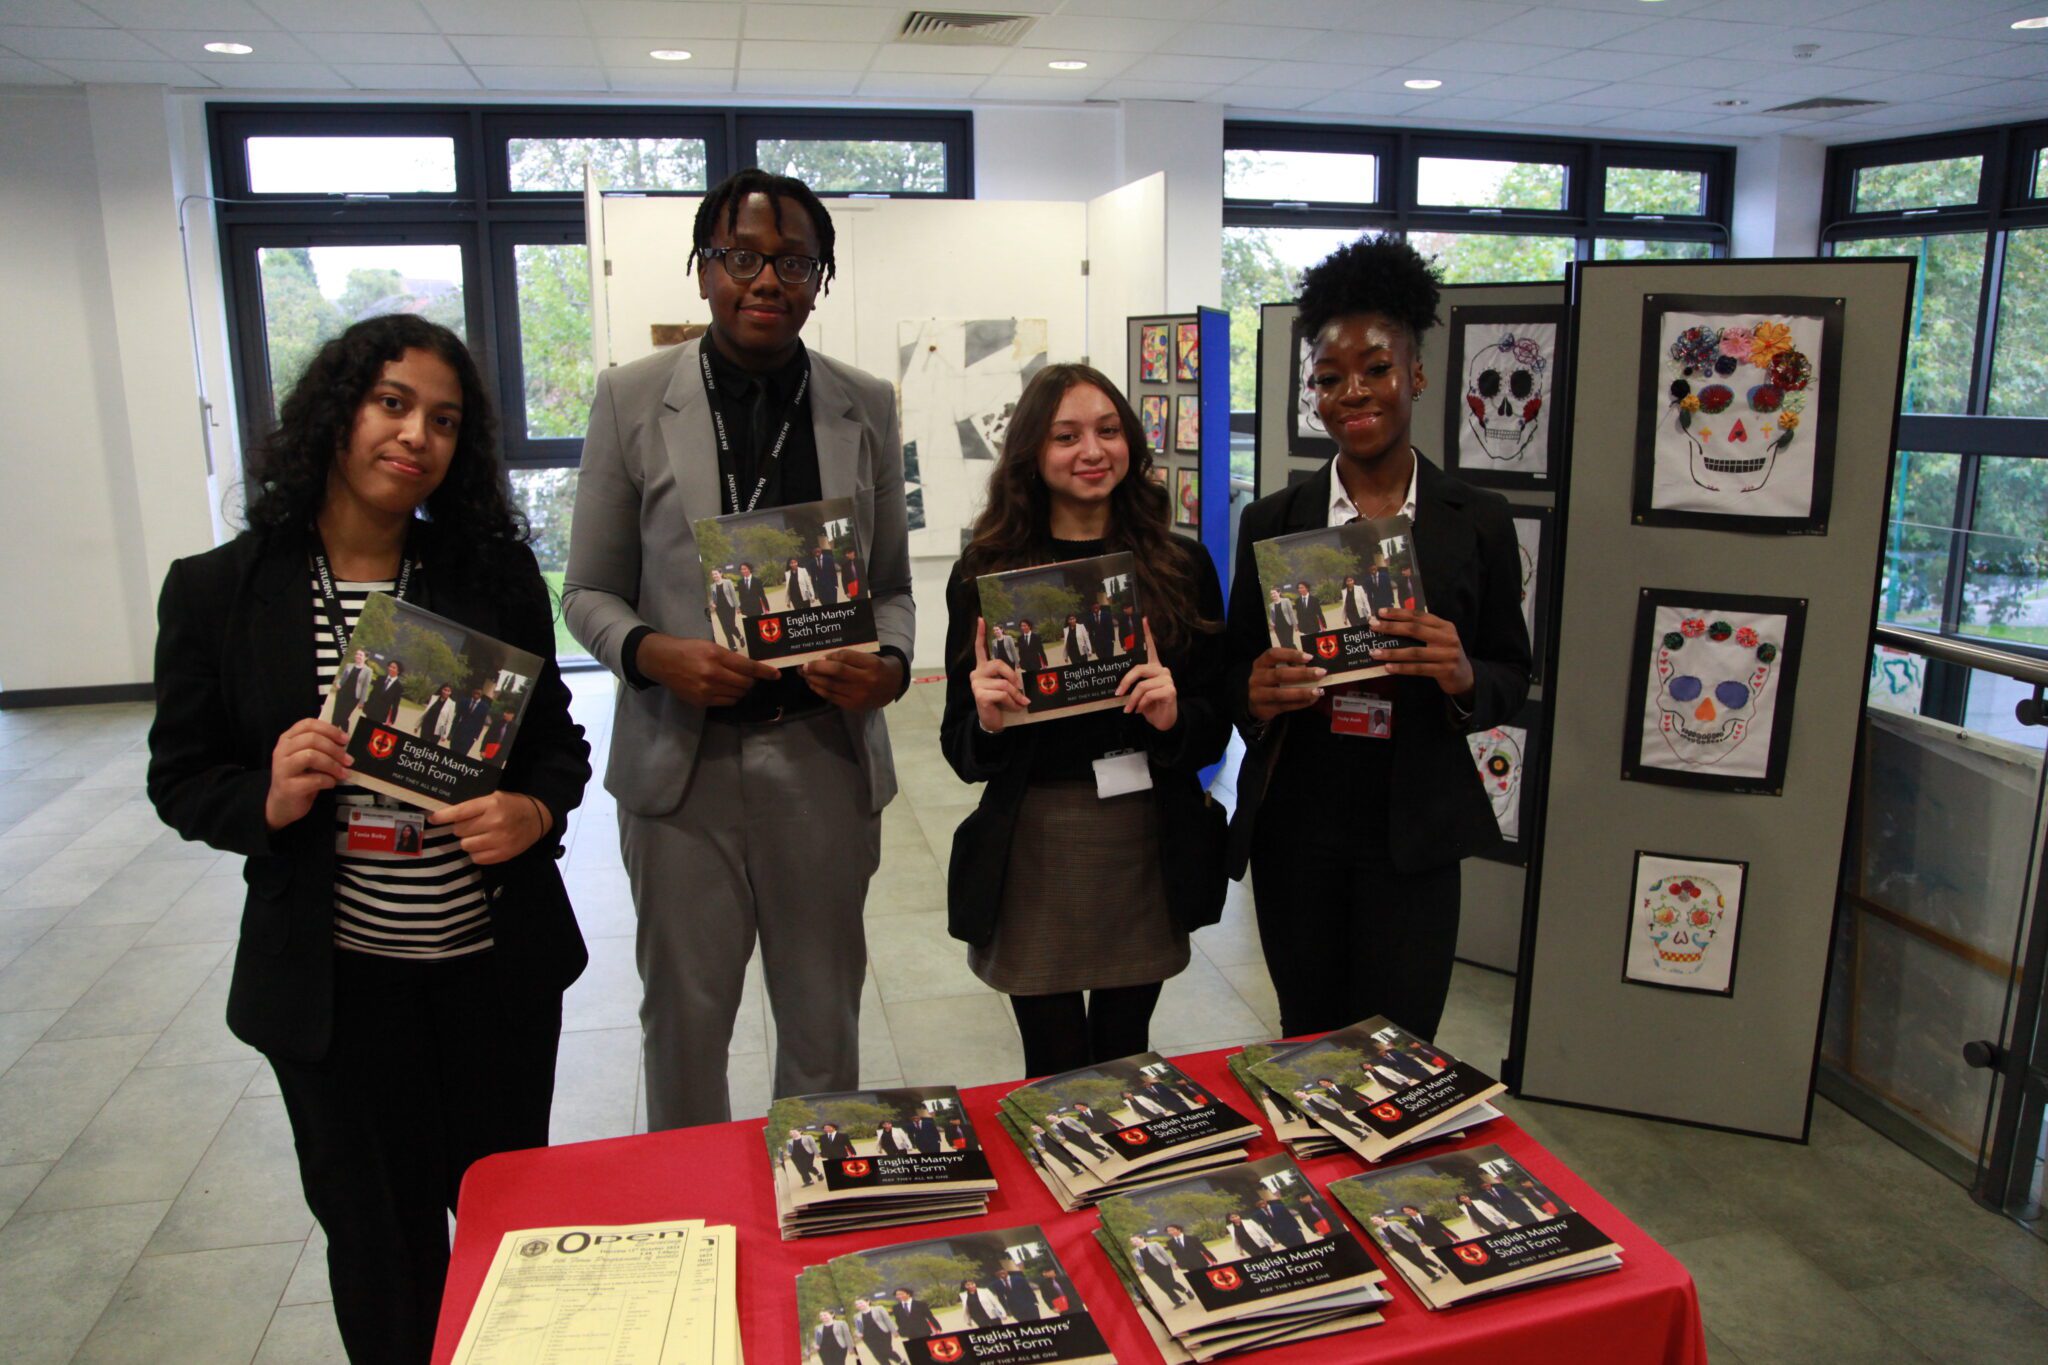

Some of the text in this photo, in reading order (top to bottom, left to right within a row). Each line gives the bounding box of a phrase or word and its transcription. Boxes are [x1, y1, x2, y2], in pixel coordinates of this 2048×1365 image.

[702, 353, 713, 379] STUDENT
[715, 411, 729, 450] EM STUDENT
[771, 421, 790, 459] EM STUDENT
[727, 474, 739, 504] STUDENT
[757, 477, 766, 488] EM
[319, 567, 334, 599] STUDENT
[399, 559, 411, 590] STUDENT
[786, 612, 819, 626] English
[335, 625, 344, 637] EM
[787, 623, 841, 639] Sixth Form
[1343, 630, 1376, 643] English
[1345, 639, 1399, 655] Sixth Form
[1063, 666, 1095, 680] English
[1065, 675, 1117, 691] Sixth Form
[402, 741, 440, 762] English
[397, 754, 457, 785] Sixth Form
[1395, 1087, 1428, 1105] English
[1404, 1085, 1456, 1112] Sixth Form
[1145, 1117, 1181, 1132] English
[1153, 1120, 1210, 1138] Sixth Form
[877, 1157, 918, 1167] English
[879, 1164, 947, 1175] Sixth Form
[556, 1230, 684, 1254] Open
[1485, 1232, 1527, 1249] English
[1494, 1236, 1561, 1258] Sixth Form
[1243, 1255, 1288, 1273] English
[1249, 1260, 1323, 1284] Sixth Form
[1275, 1283, 1292, 1291] THEY
[968, 1328, 1017, 1344] English
[973, 1337, 1053, 1357] Sixth Form
